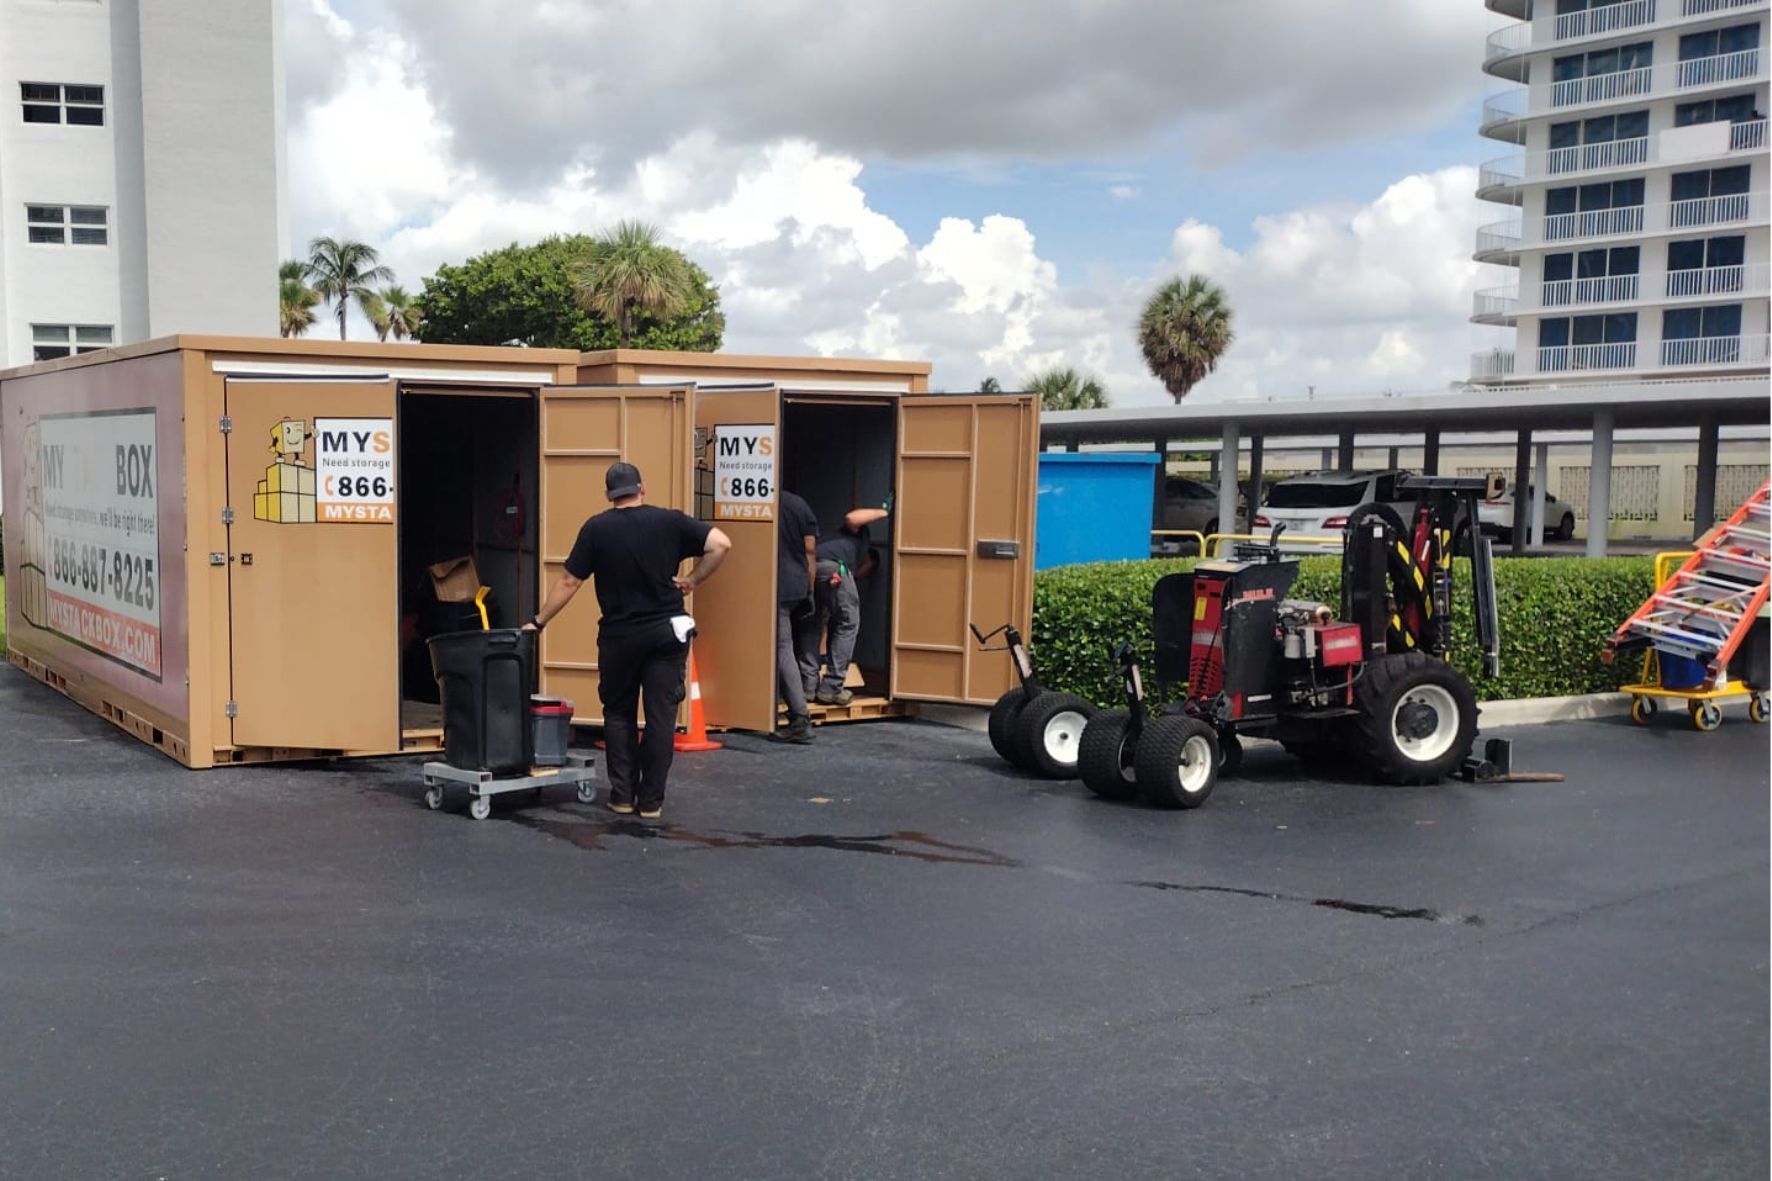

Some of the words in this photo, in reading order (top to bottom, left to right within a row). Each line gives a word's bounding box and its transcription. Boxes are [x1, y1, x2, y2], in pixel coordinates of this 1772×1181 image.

[43, 445, 64, 489] MY
[116, 443, 154, 499] BOX
[322, 458, 349, 467] Need
[351, 458, 390, 470] storage
[720, 461, 740, 470] Need
[741, 461, 772, 472] storage
[325, 505, 391, 519] MYSTA
[720, 504, 772, 518] MYSTA
[54, 537, 154, 611] 866-887-8225
[49, 598, 155, 665] MYSTACKBOX.COM
